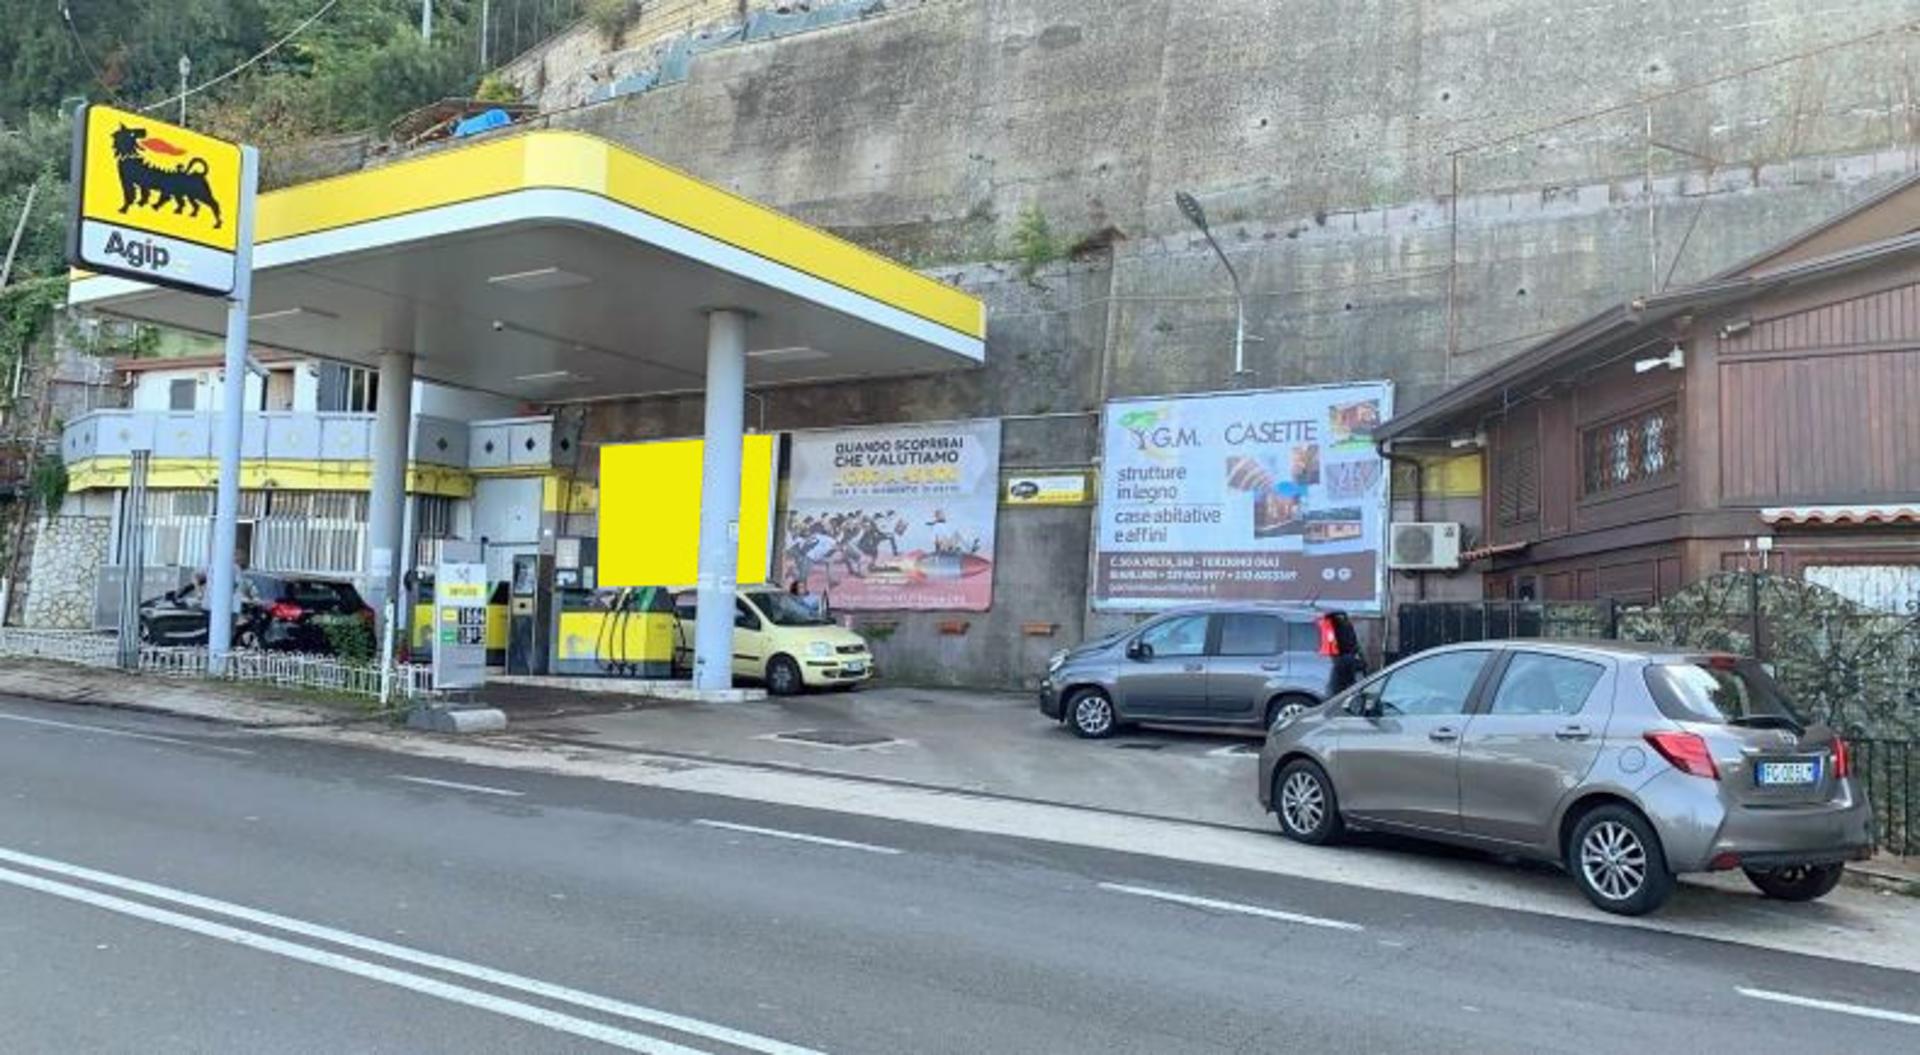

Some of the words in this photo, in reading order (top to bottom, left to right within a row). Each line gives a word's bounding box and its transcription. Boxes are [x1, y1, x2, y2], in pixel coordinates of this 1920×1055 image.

[103, 230, 170, 269] Agip
[1224, 419, 1318, 445] CASETTE
[835, 441, 892, 454] QUANDO
[894, 437, 963, 451] SCOPRIRAI
[834, 454, 863, 467] CHE
[867, 450, 959, 466] VALUTIAMO
[1117, 466, 1187, 482] strutture
[1117, 484, 1131, 499] in
[1132, 483, 1178, 504] legno
[1114, 509, 1151, 524] case
[1152, 506, 1221, 524] abitative
[1114, 529, 1124, 543] e
[1125, 526, 1168, 543] affini
